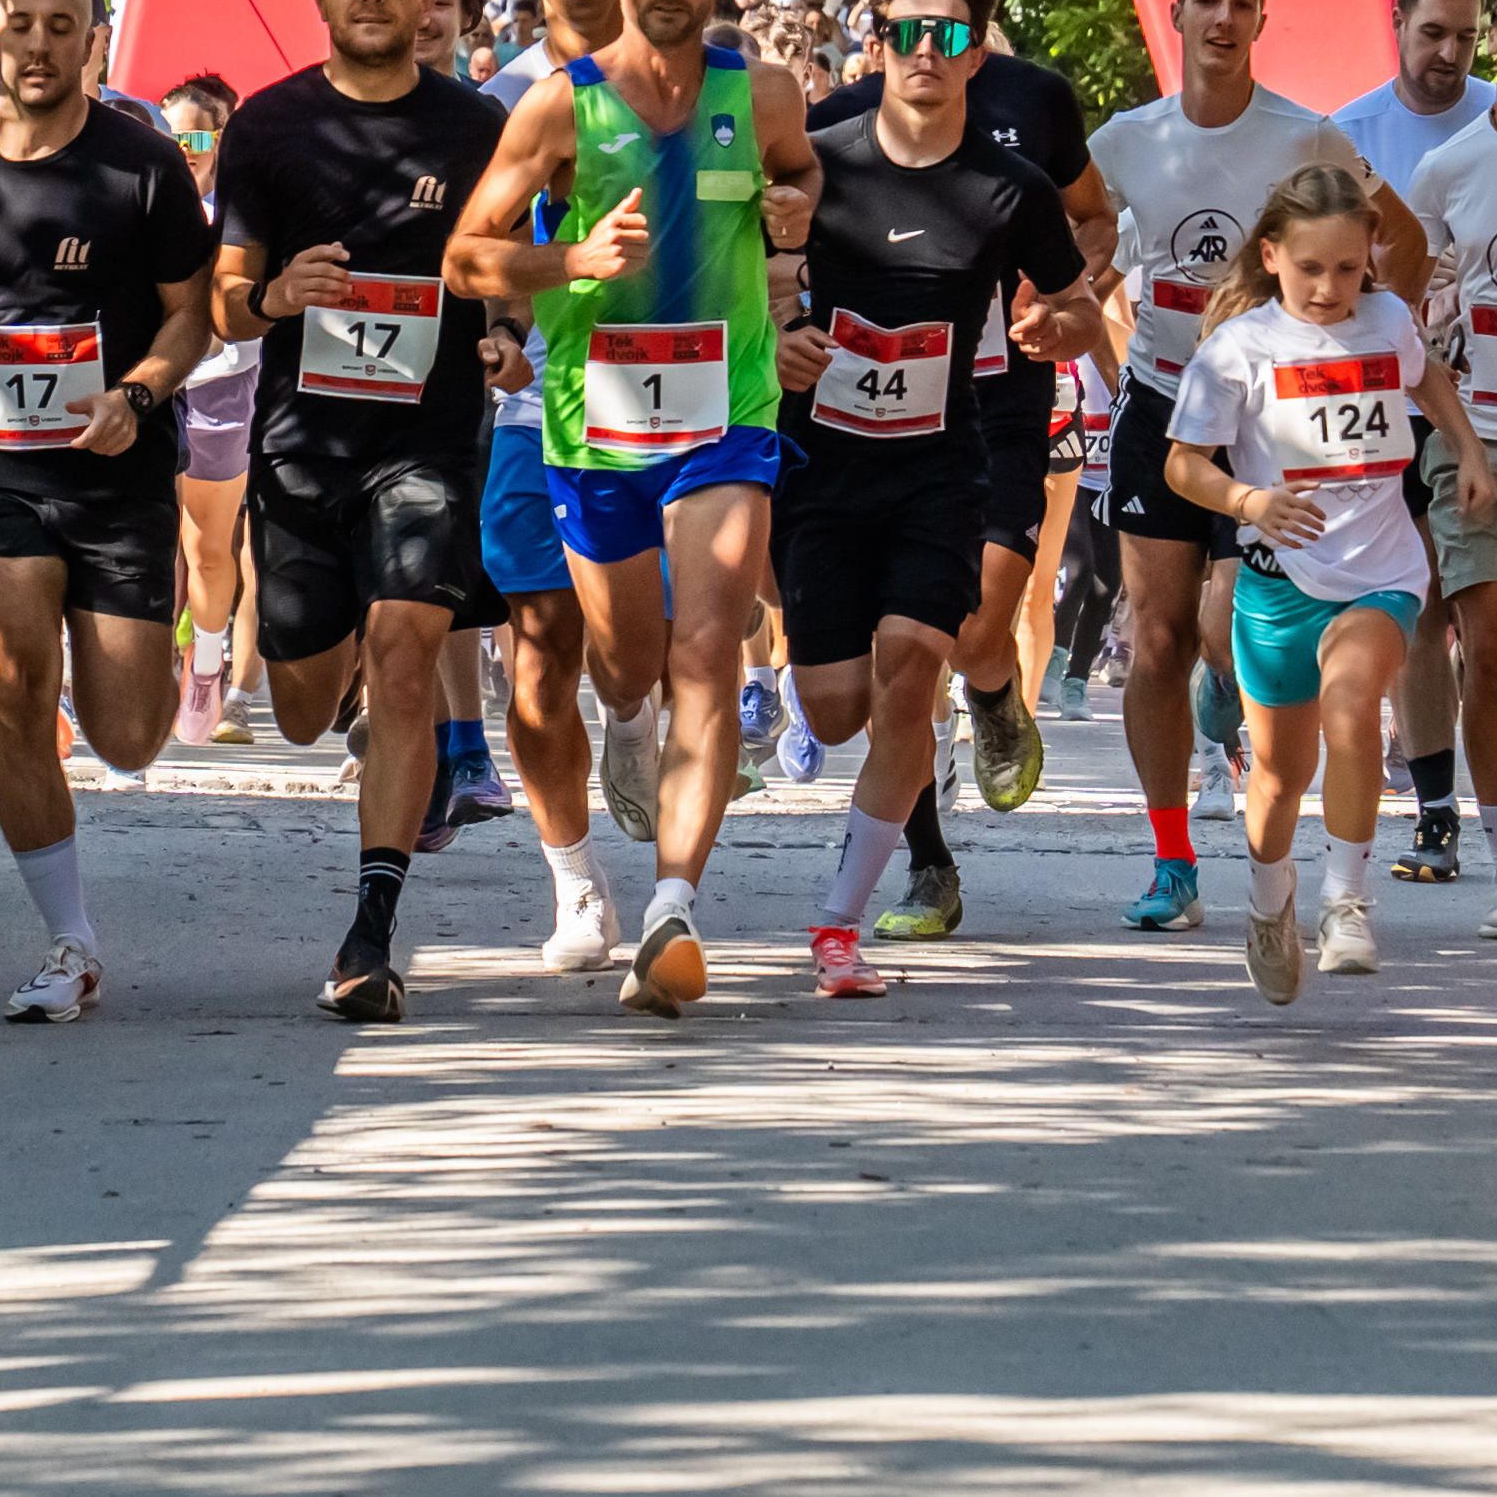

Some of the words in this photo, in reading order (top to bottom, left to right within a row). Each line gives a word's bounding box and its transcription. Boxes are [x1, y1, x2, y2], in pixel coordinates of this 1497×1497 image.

[54, 236, 91, 264] fit
[347, 320, 402, 359] 17
[5, 373, 58, 409] 17
[642, 373, 662, 410] 1
[856, 368, 908, 401] 44
[1309, 400, 1390, 443] 124
